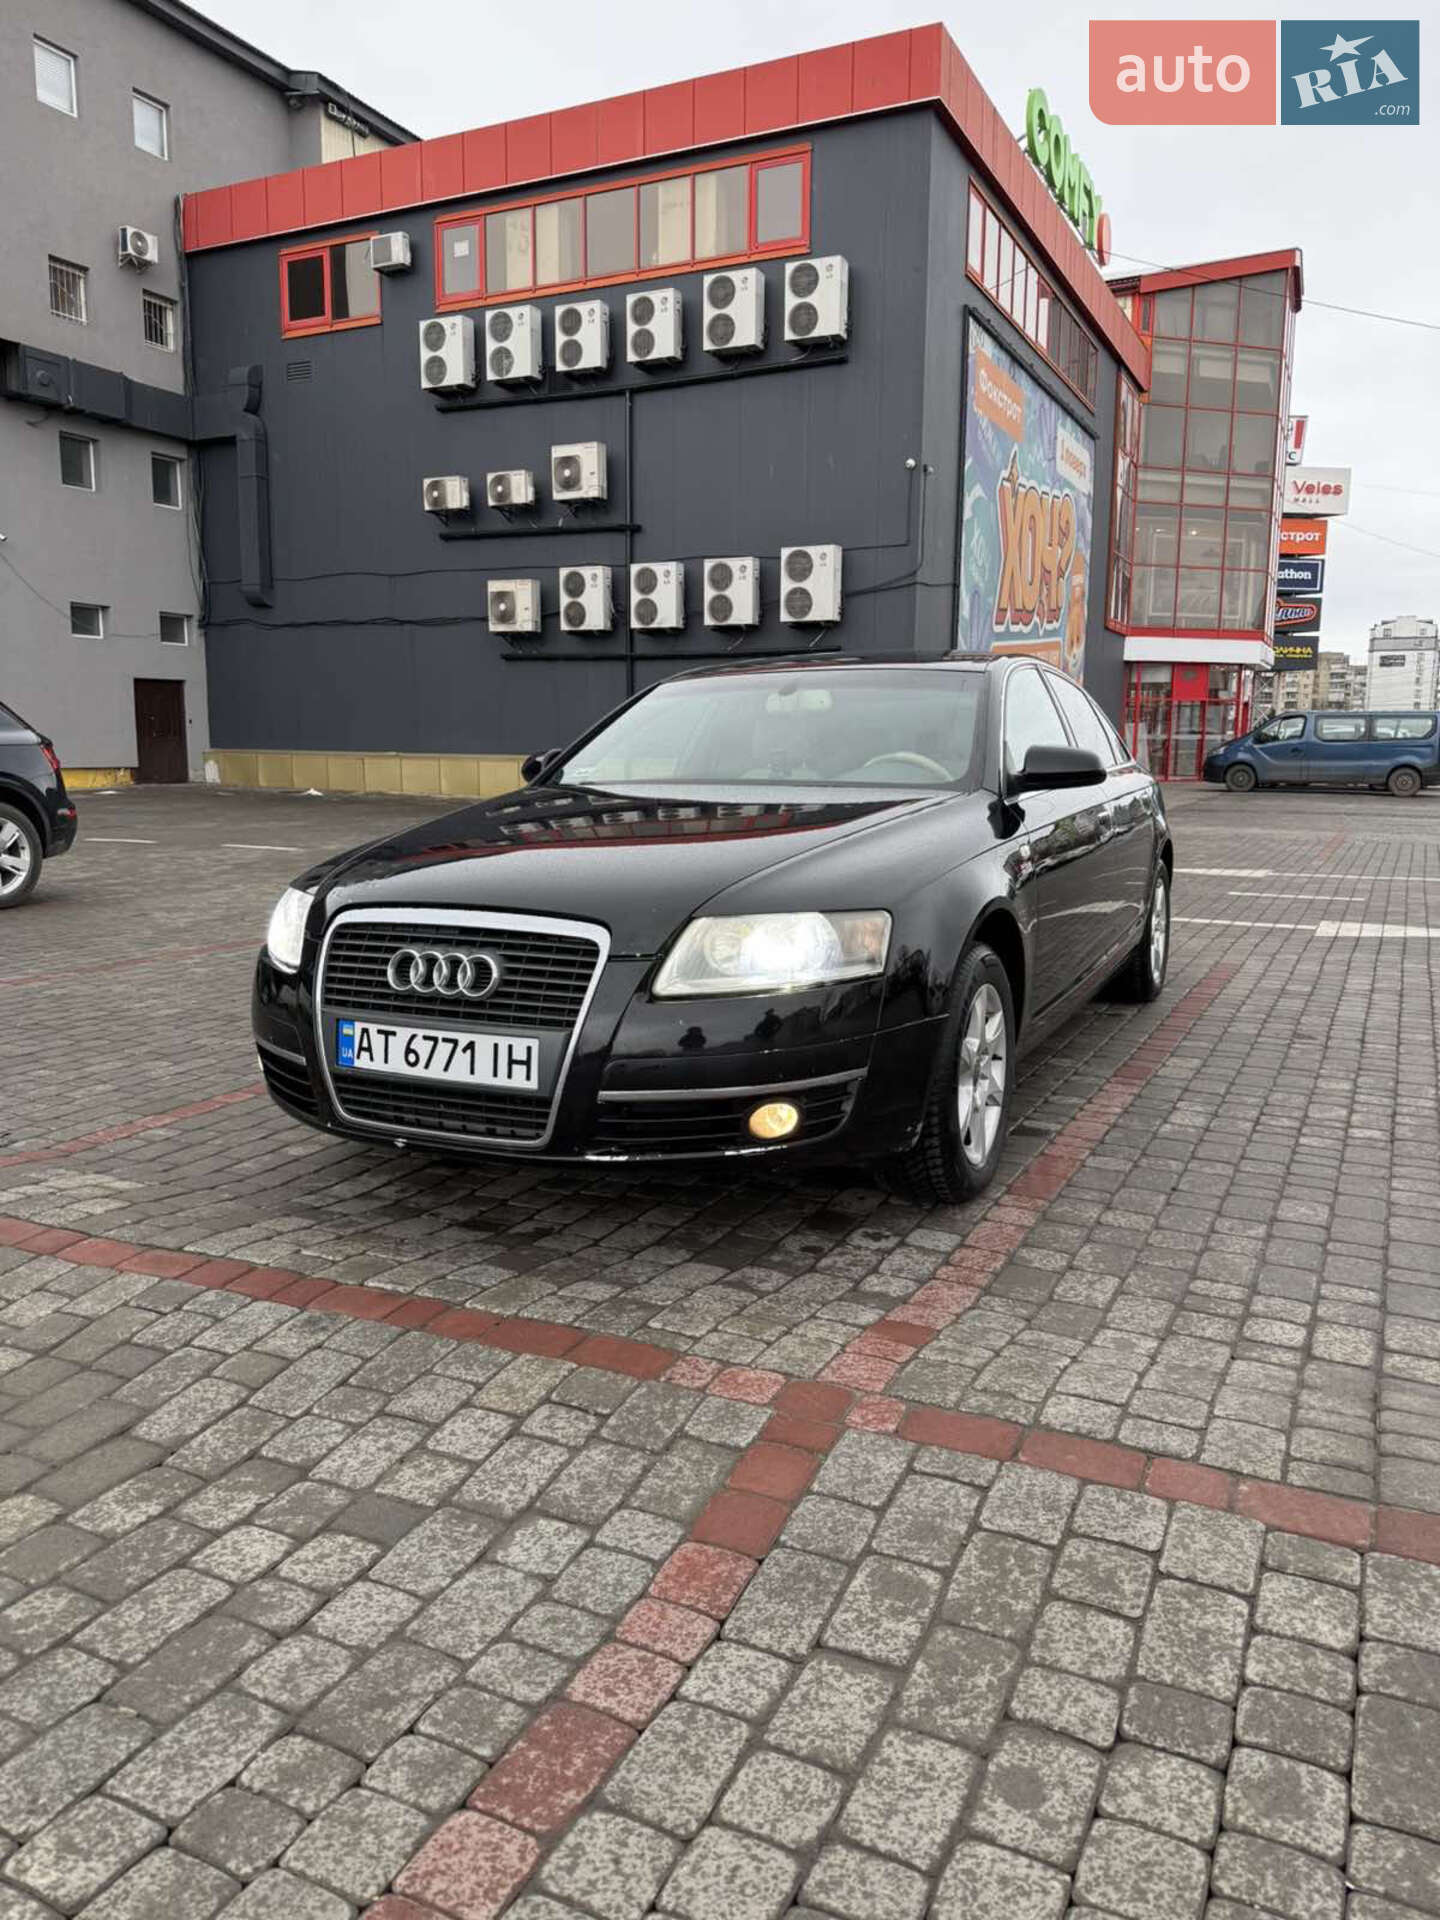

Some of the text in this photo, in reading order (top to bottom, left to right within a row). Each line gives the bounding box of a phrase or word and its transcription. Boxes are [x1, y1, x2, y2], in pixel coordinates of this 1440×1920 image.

[1293, 480, 1343, 496] Veles
[1279, 531, 1320, 544] строт
[1277, 568, 1312, 580] athon
[342, 1047, 354, 1059] UA
[356, 1027, 532, 1082] AT 6771 IH
